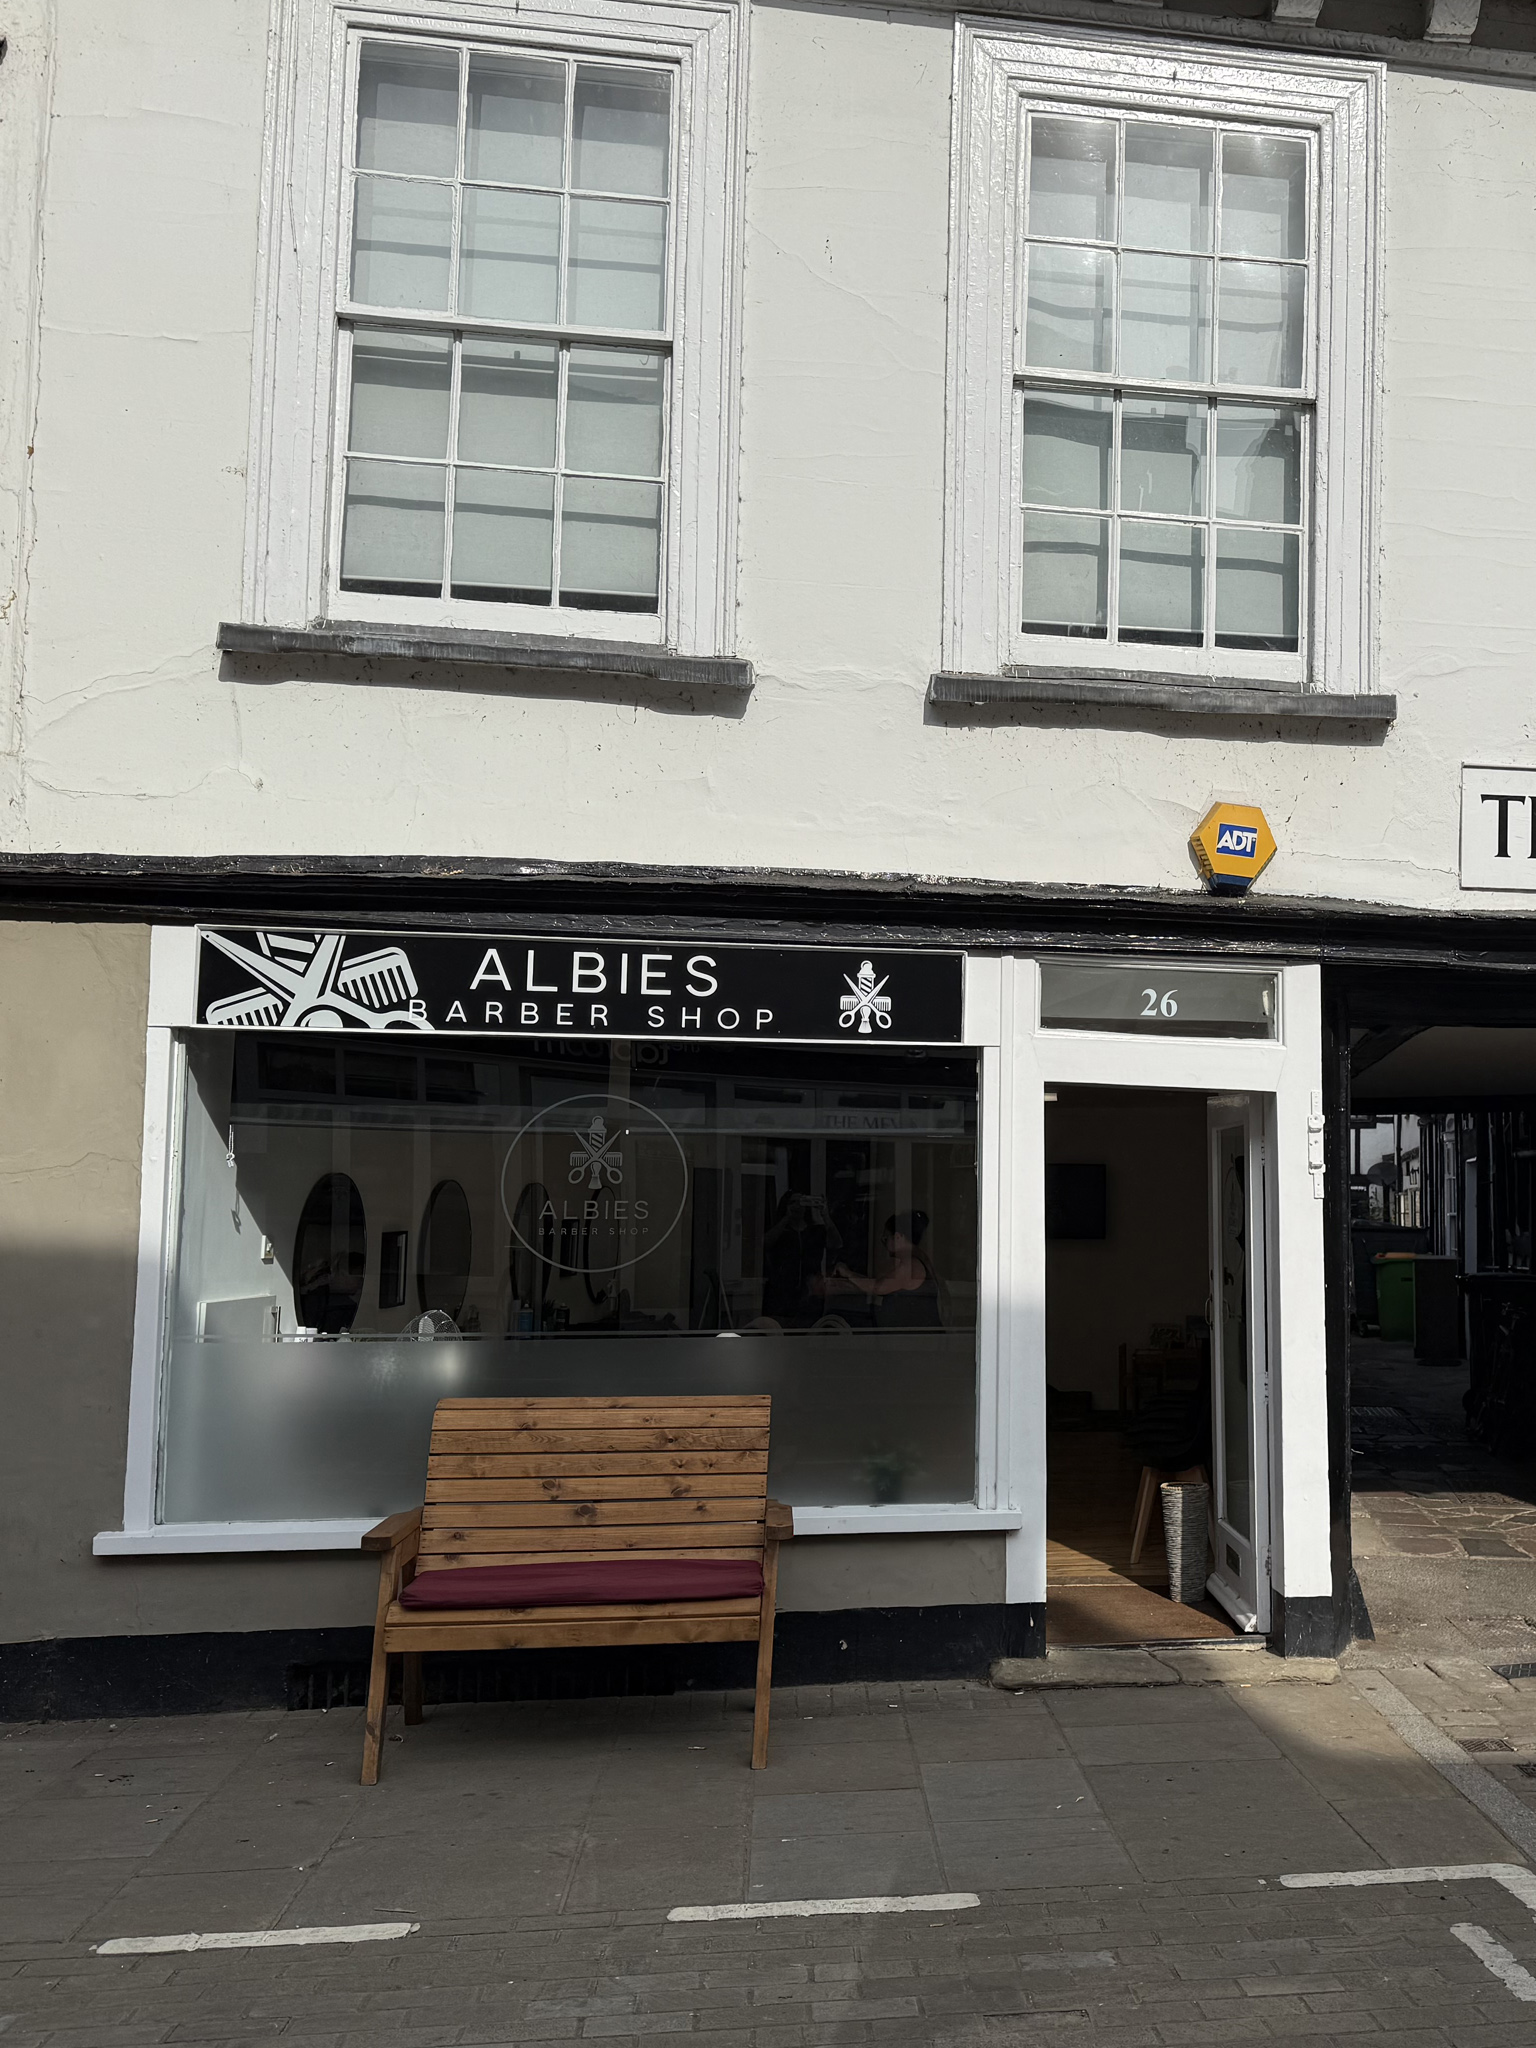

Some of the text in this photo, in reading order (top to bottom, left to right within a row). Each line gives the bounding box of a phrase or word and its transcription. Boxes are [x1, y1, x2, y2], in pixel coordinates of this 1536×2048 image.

[1480, 793, 1536, 859] T
[1217, 829, 1257, 854] ADT
[469, 948, 718, 998] ALBIES
[408, 999, 774, 1031] BARBER SHOP
[1139, 988, 1179, 1018] 26
[538, 1200, 649, 1220] ALBIES
[538, 1227, 649, 1236] BARBER SHOP
